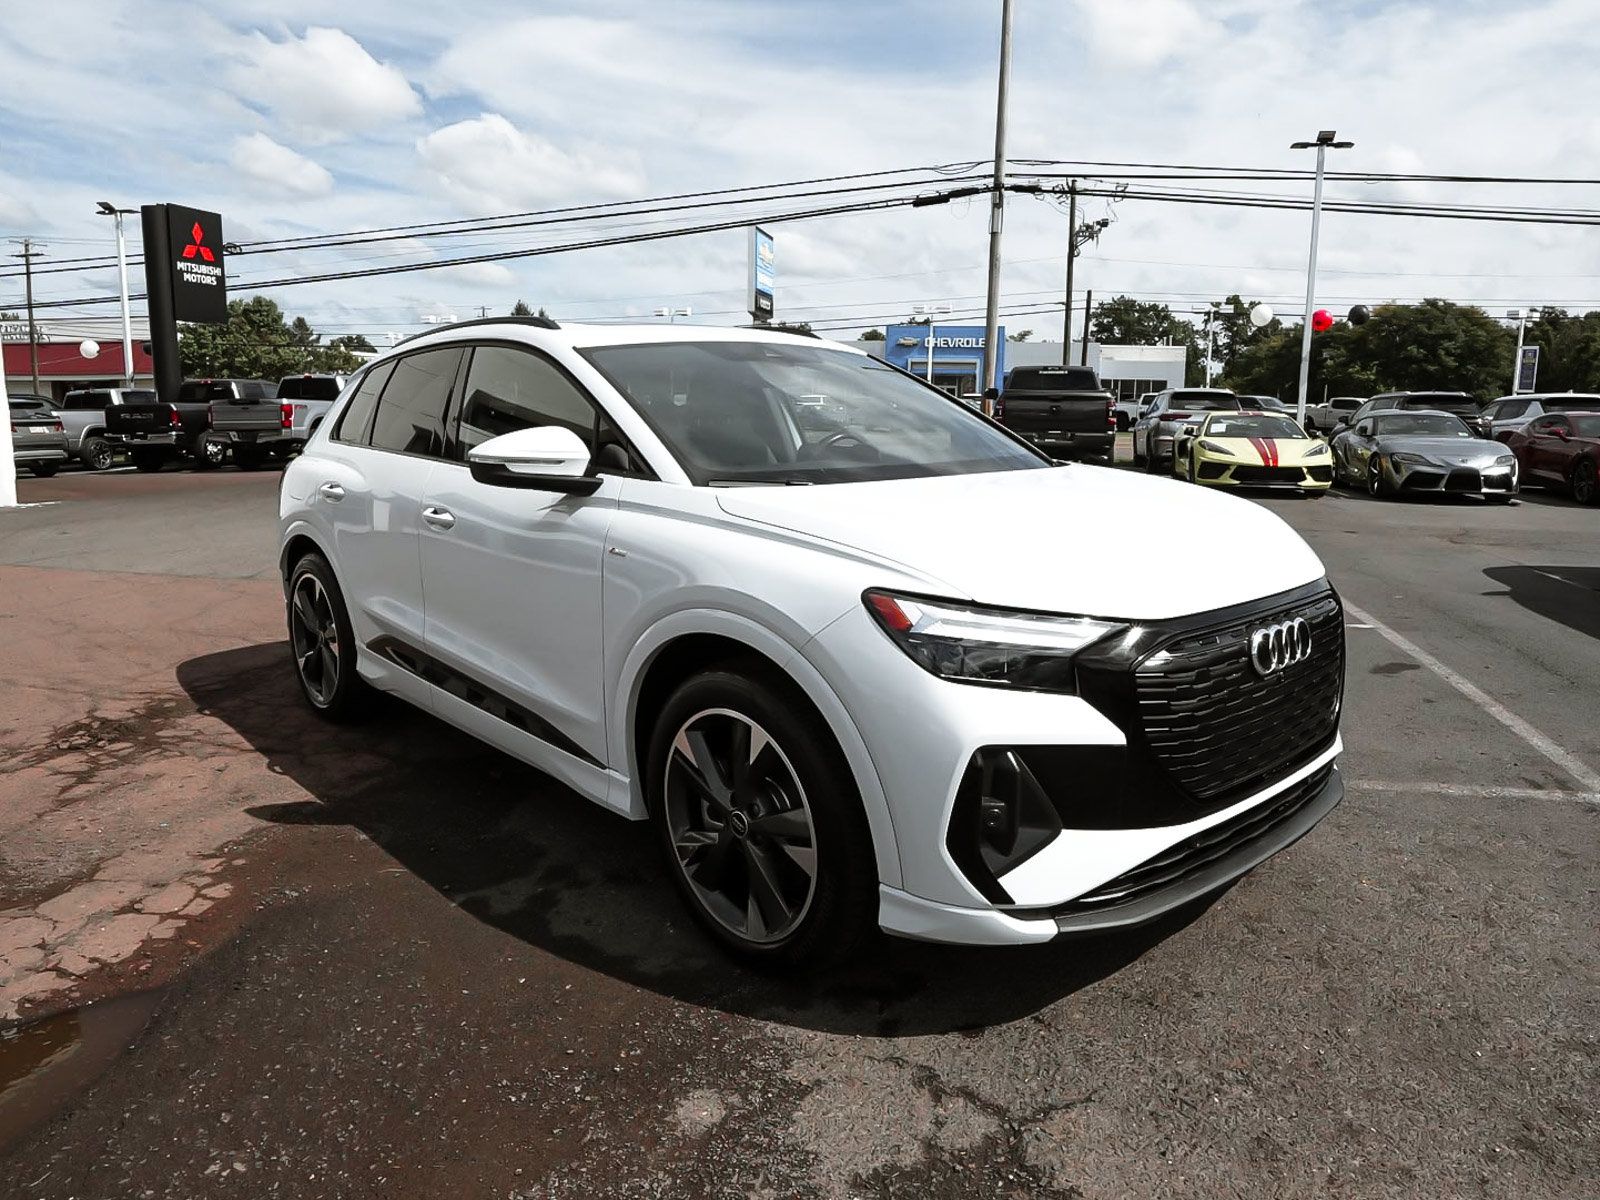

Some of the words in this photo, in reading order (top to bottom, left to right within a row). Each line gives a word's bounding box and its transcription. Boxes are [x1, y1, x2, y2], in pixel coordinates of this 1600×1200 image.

[176, 261, 222, 277] MITSUBISHI
[183, 272, 217, 286] MOTORS
[924, 337, 986, 348] CHEVROLE
